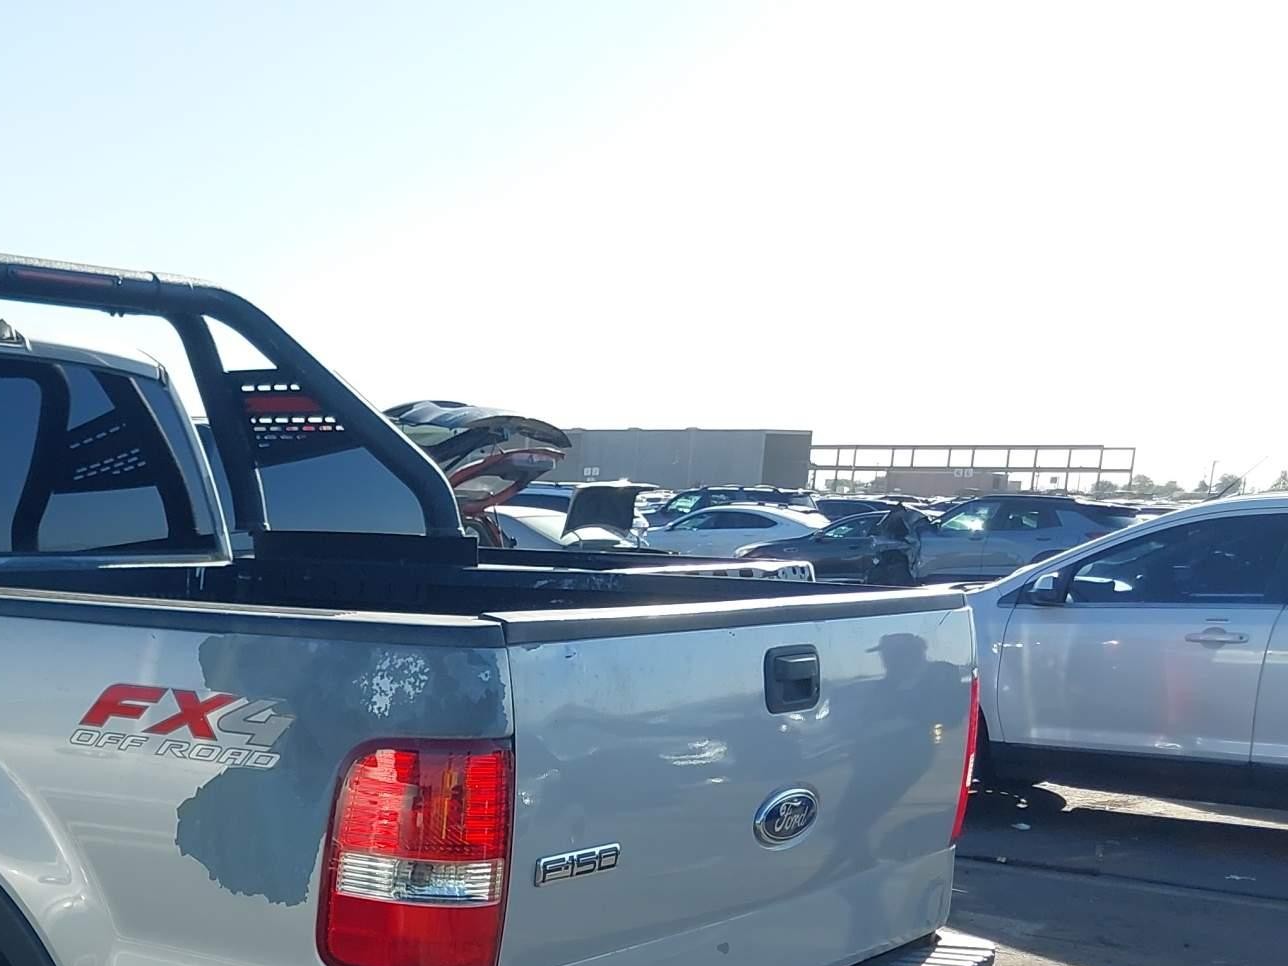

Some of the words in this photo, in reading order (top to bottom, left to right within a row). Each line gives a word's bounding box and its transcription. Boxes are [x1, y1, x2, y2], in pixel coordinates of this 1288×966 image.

[79, 683, 295, 746] FX4
[69, 728, 149, 751] OFF
[156, 739, 281, 769] ROAD
[773, 798, 808, 832] Ford
